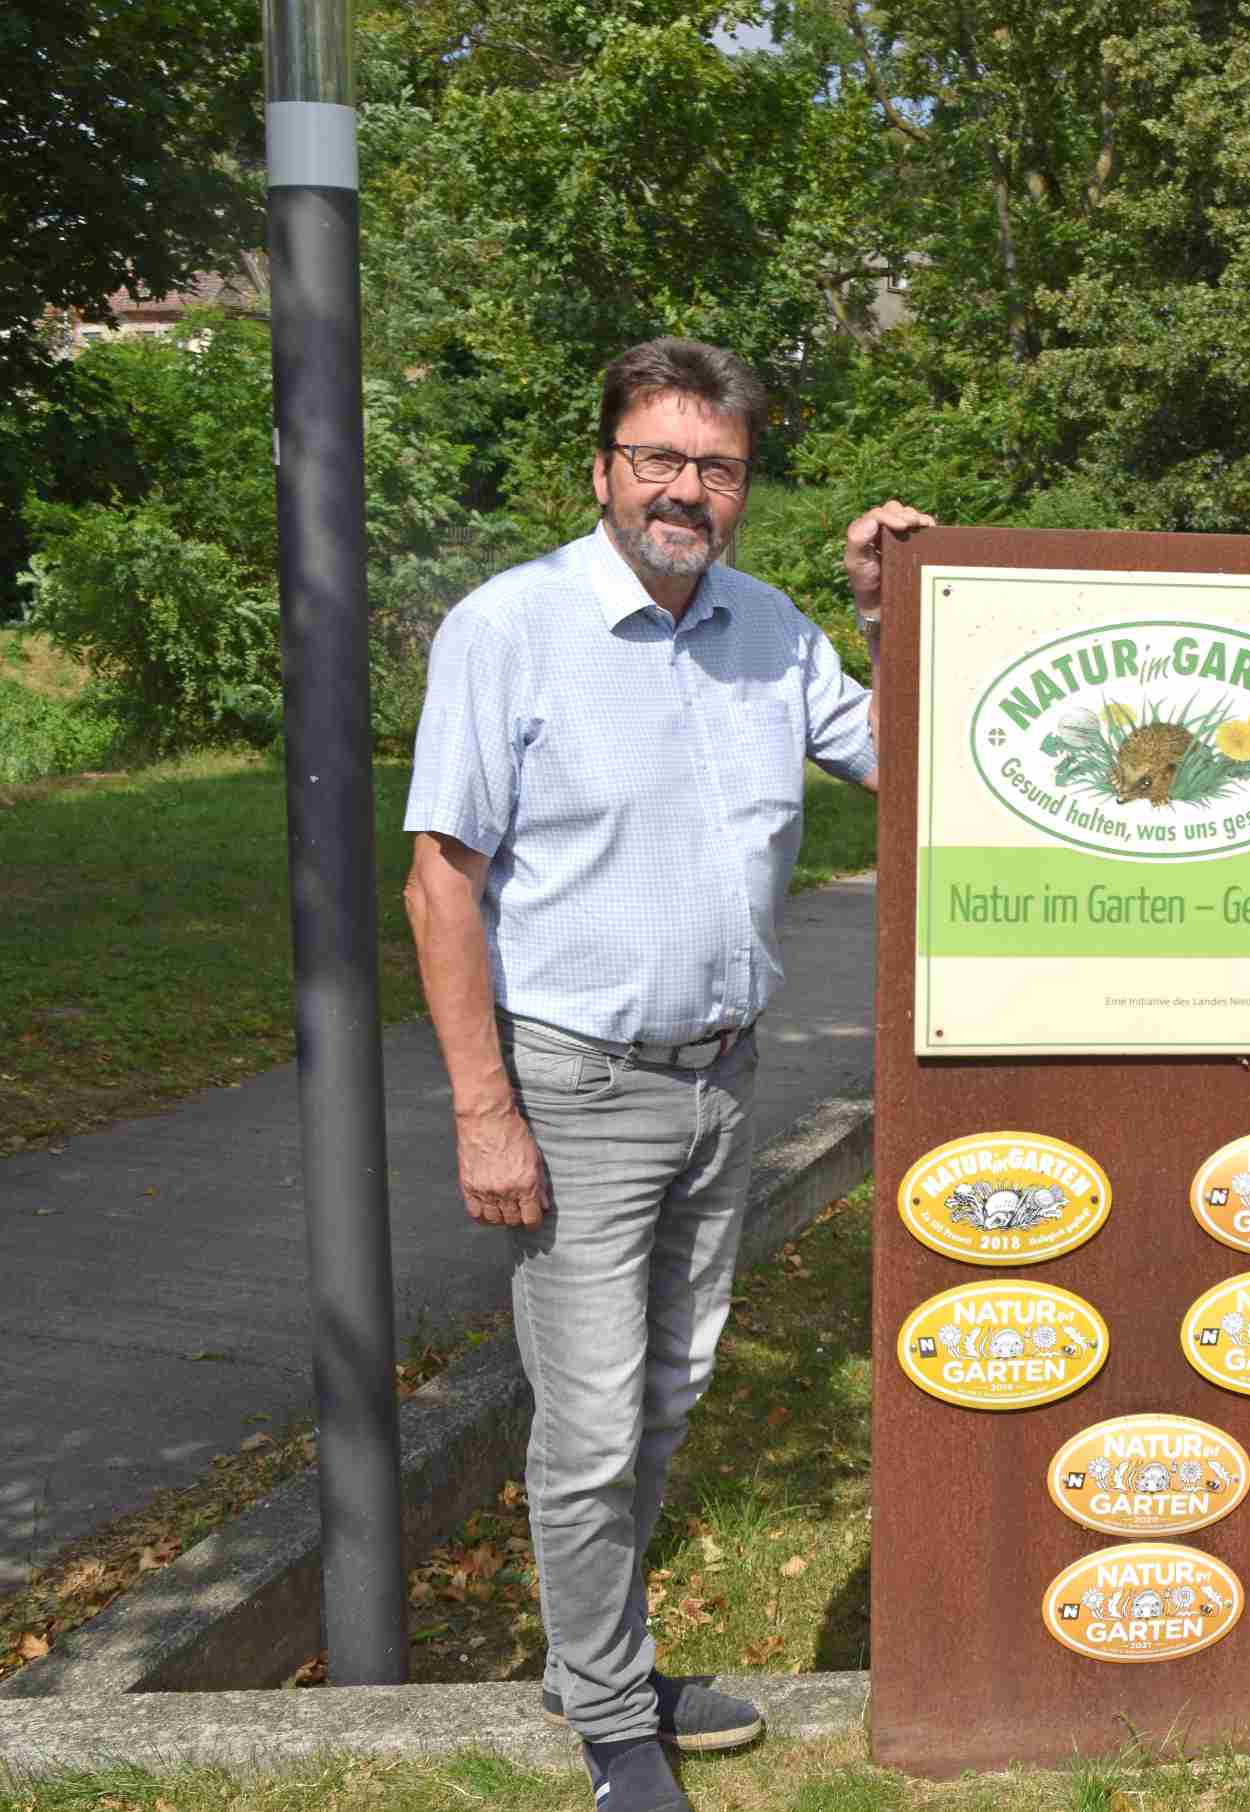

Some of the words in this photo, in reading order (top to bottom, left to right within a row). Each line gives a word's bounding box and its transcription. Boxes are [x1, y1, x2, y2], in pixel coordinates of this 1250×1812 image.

[998, 638, 1139, 731] NATUR
[1139, 644, 1171, 686] im
[1000, 757, 1062, 816] Gesund
[1065, 804, 1131, 842] halten,
[1137, 823, 1176, 841] was
[1184, 821, 1217, 841] uns
[949, 882, 1034, 924] Natur
[1043, 883, 1078, 924] im
[1088, 884, 1185, 925] Garten
[1104, 996, 1127, 1007] Eine
[1172, 996, 1190, 1007] des
[1192, 996, 1226, 1008] Landes
[922, 1151, 993, 1197] NATUR
[1008, 1148, 1092, 1197] GARTEN
[979, 1235, 1021, 1250] 2018
[953, 1300, 1057, 1325] NATUR
[943, 1360, 1065, 1383] GARTEN
[1103, 1434, 1204, 1457] NATUR
[1090, 1493, 1209, 1515] GARTEN
[1098, 1563, 1194, 1587] NATUR
[1086, 1618, 1203, 1642] GARTEN
